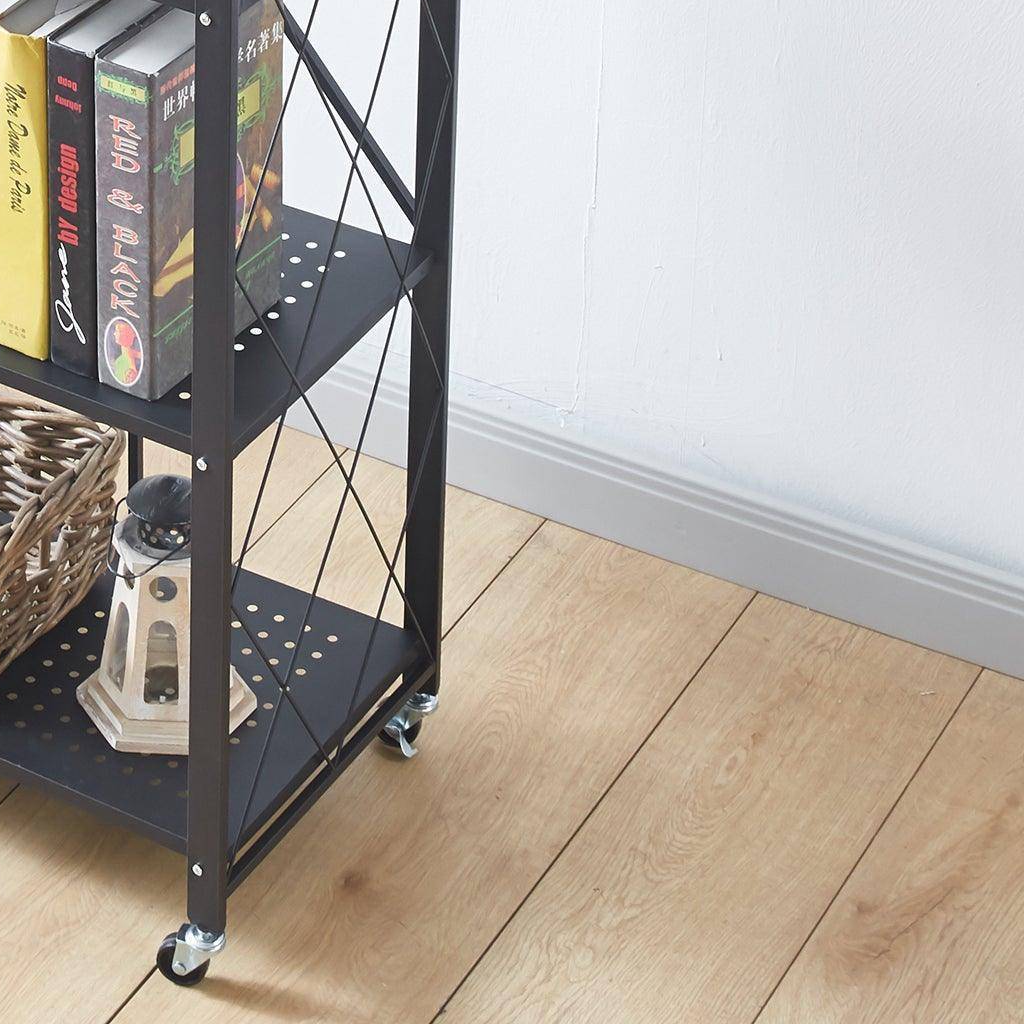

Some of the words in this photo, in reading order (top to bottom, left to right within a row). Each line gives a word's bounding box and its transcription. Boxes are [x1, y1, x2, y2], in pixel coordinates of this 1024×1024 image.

[4, 81, 27, 118] Notre
[7, 120, 29, 159] Dame
[108, 114, 142, 174] RED
[9, 159, 28, 176] de
[57, 143, 80, 214] design
[9, 176, 32, 214] Paris
[107, 188, 145, 215] &
[110, 223, 141, 319] BLACK
[55, 242, 87, 345] Jane
